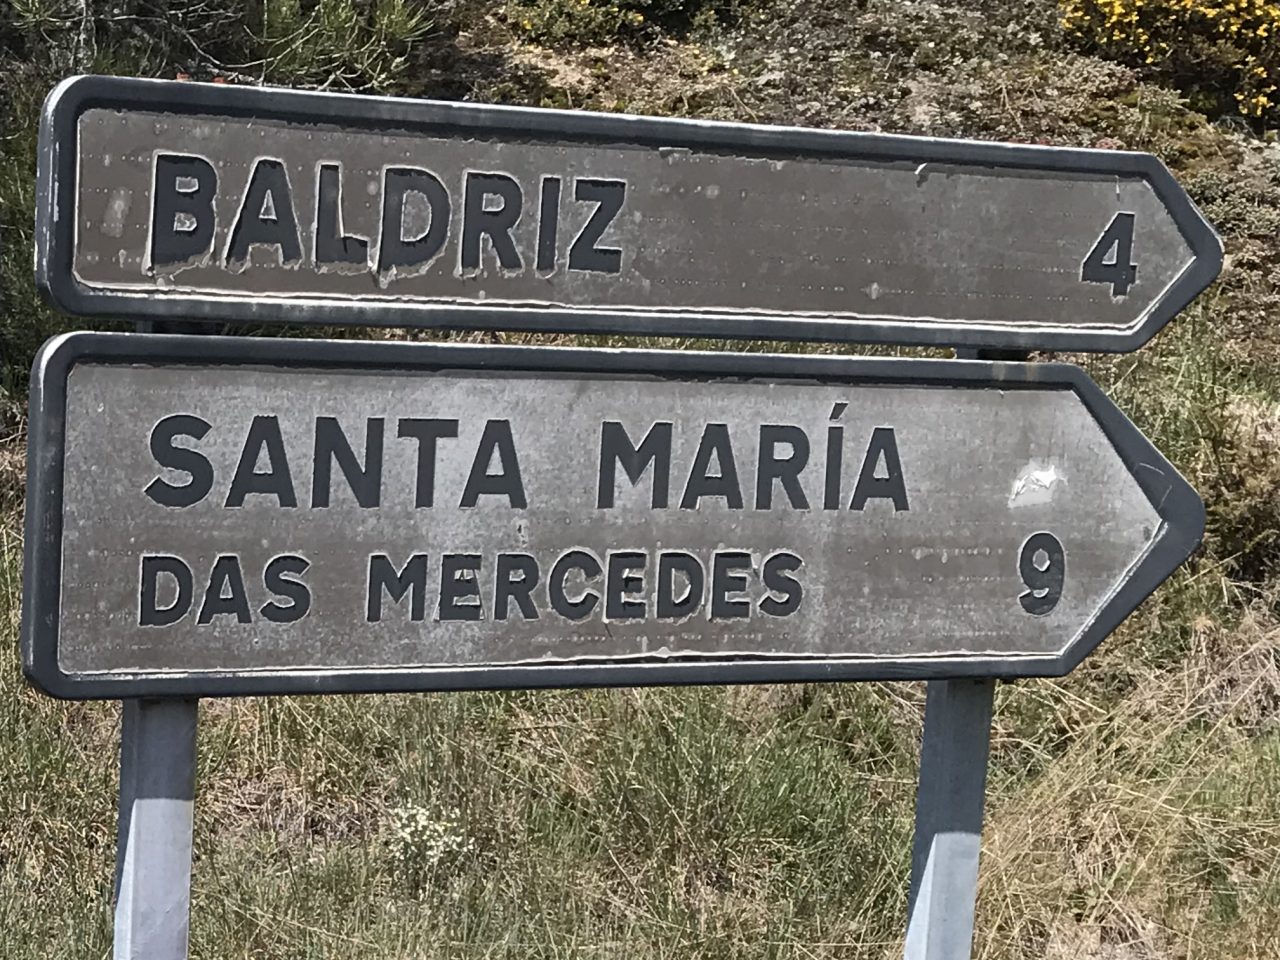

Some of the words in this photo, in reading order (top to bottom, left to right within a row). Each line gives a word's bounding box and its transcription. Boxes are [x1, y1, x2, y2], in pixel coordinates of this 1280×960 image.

[150, 152, 627, 279] BALDRIZ
[1080, 211, 1138, 299] 4
[144, 413, 528, 509] SANTA
[596, 401, 911, 512] MARÍA
[138, 553, 312, 627] DAS
[366, 547, 805, 624] MERCEDES
[1017, 530, 1067, 618] 9
